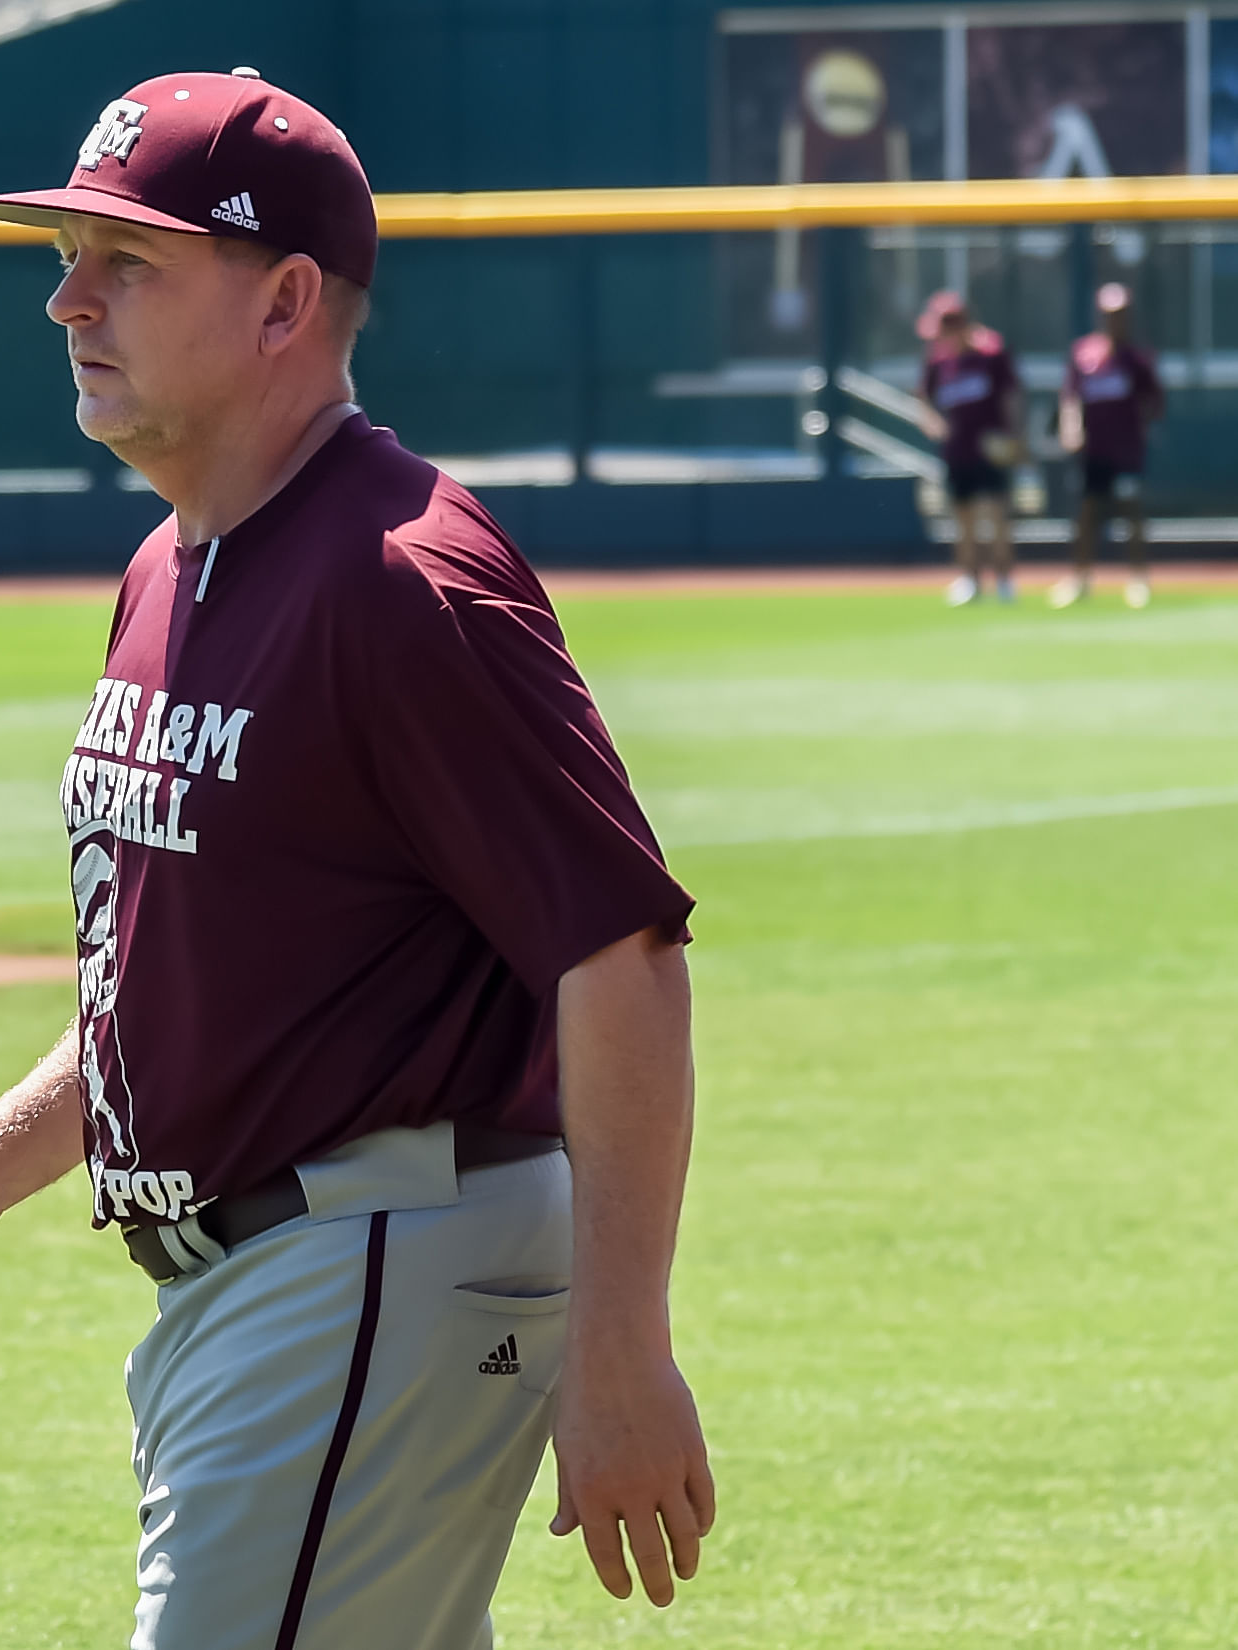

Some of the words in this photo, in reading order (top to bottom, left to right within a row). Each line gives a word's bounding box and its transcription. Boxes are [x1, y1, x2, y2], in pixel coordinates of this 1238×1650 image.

[210, 205, 261, 231] adidas
[73, 677, 143, 757] XAS
[135, 689, 253, 782] A&M
[60, 753, 198, 855] ASEBALL
